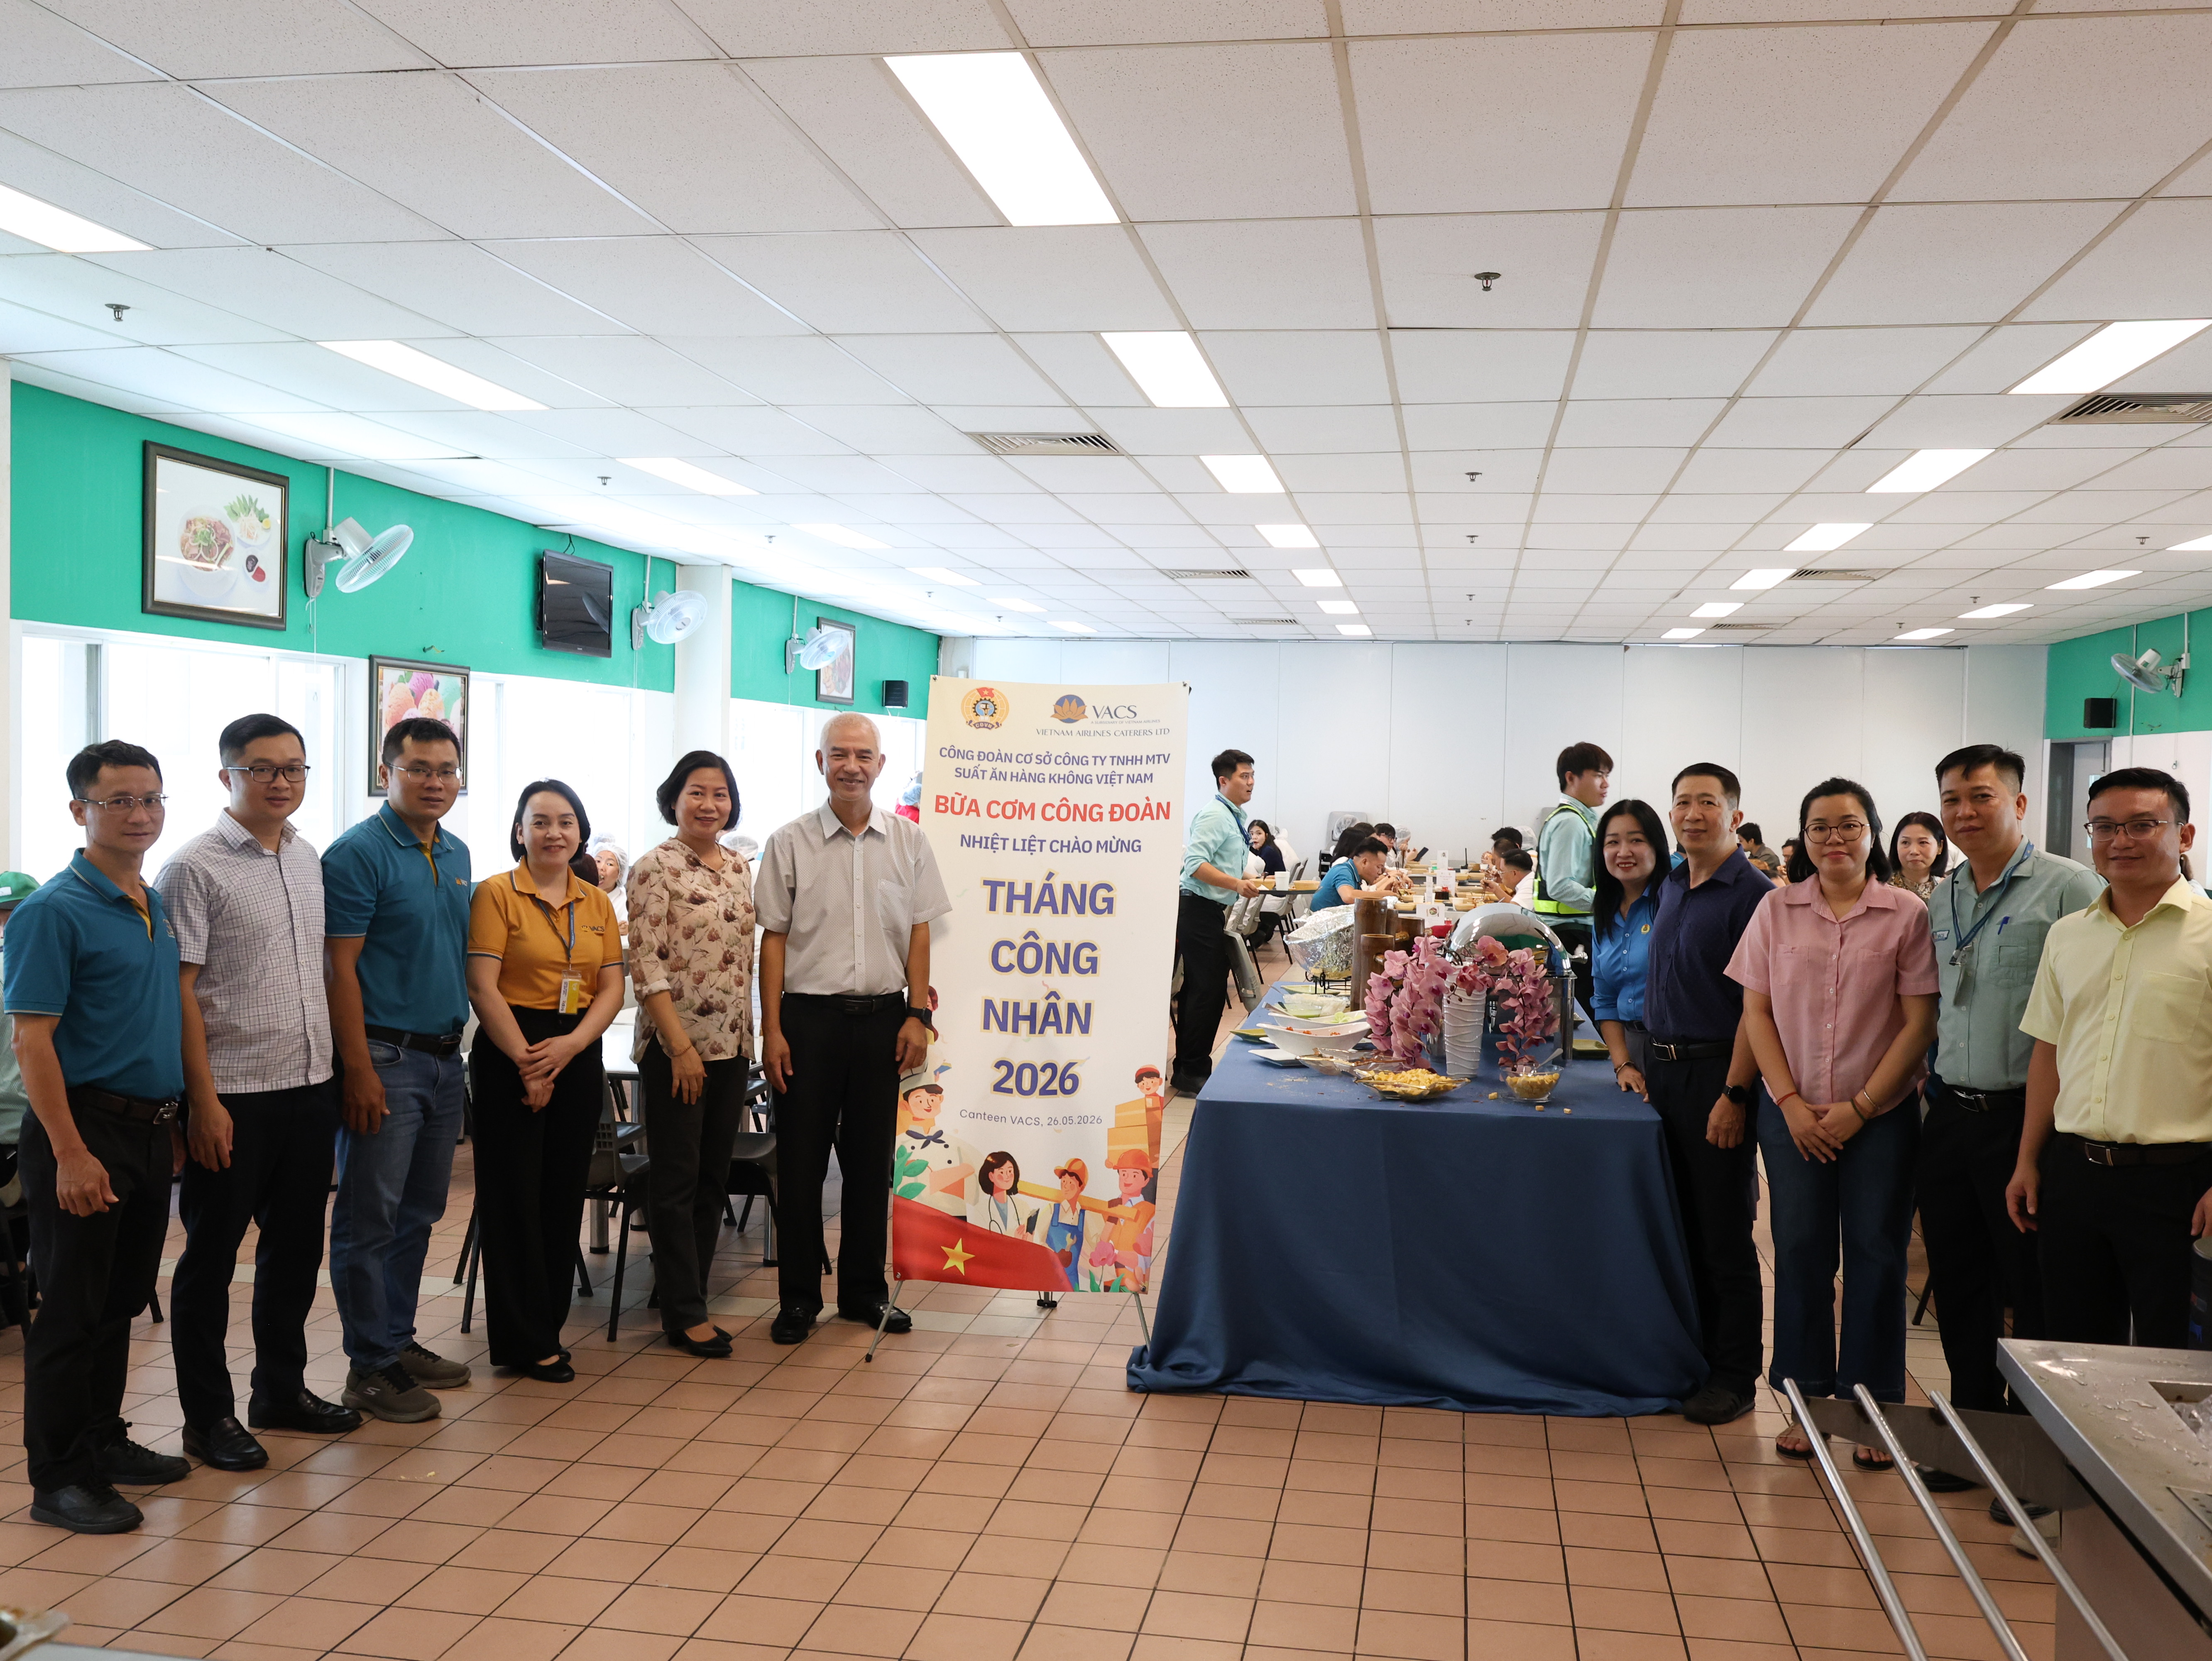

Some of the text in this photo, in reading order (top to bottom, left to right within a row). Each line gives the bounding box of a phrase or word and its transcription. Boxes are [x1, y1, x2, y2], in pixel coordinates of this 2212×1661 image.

[1092, 705, 1137, 719] VACS
[940, 745, 1171, 766] CÔNG ĐOÀN CƠ SỞ CÔNG TY TNHH MTV
[954, 764, 1153, 787] SUẤT ĂN HÀNG KHÔNG VIỆT NAM
[935, 791, 1171, 822] BỮA CƠM CÔNG ĐOÀN
[960, 832, 1142, 855] NHIỆT LIỆT CHÀO MỪNG
[982, 871, 1115, 916] THÁNG
[991, 930, 1099, 975] CÔNG
[982, 991, 1093, 1035] NHÂN
[993, 1059, 1080, 1096] 2026
[960, 1109, 1102, 1127] Canteen VACS, 26.05.2026
